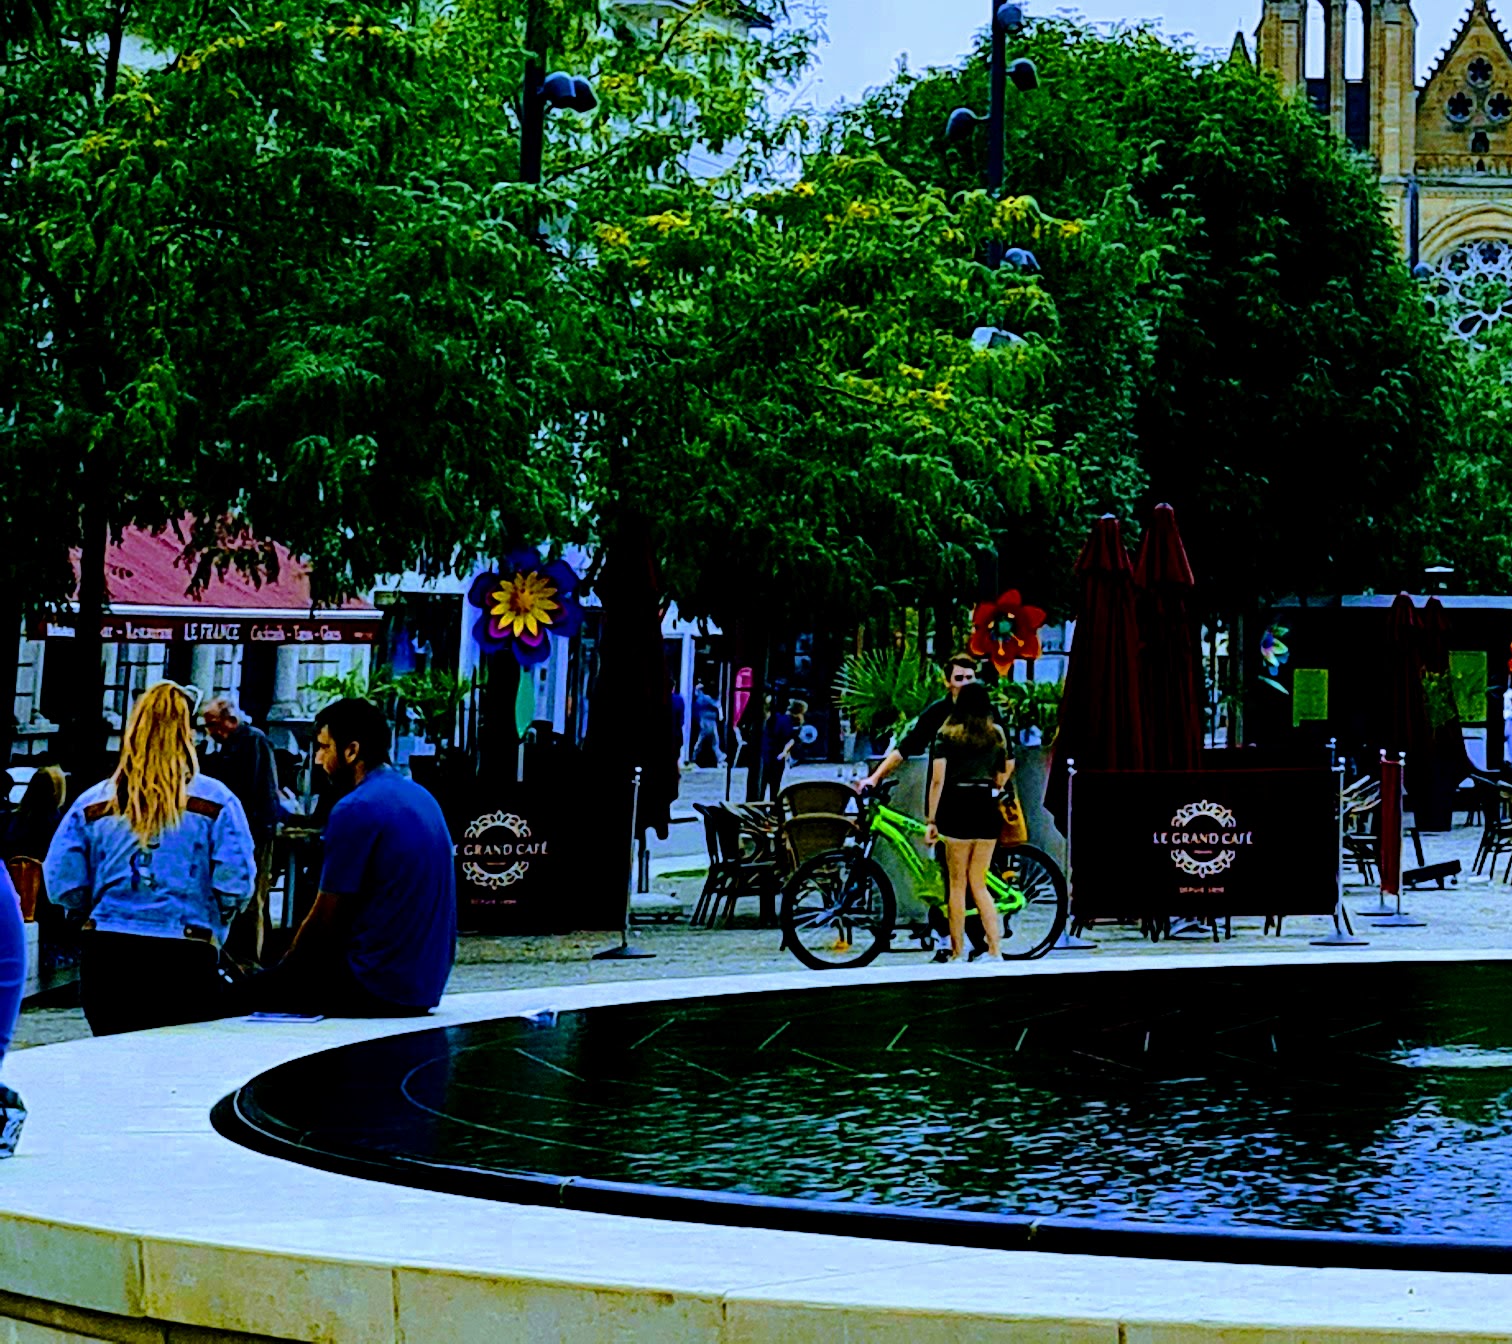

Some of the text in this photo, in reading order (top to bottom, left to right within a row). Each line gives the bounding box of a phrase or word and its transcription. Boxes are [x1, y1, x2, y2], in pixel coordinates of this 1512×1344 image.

[184, 623, 199, 641] LE
[200, 623, 242, 640] FRANCE
[1153, 831, 1253, 845] LE GRAND CAFÉ
[463, 844, 513, 856] GRAND
[516, 840, 549, 856] CAFÉ
